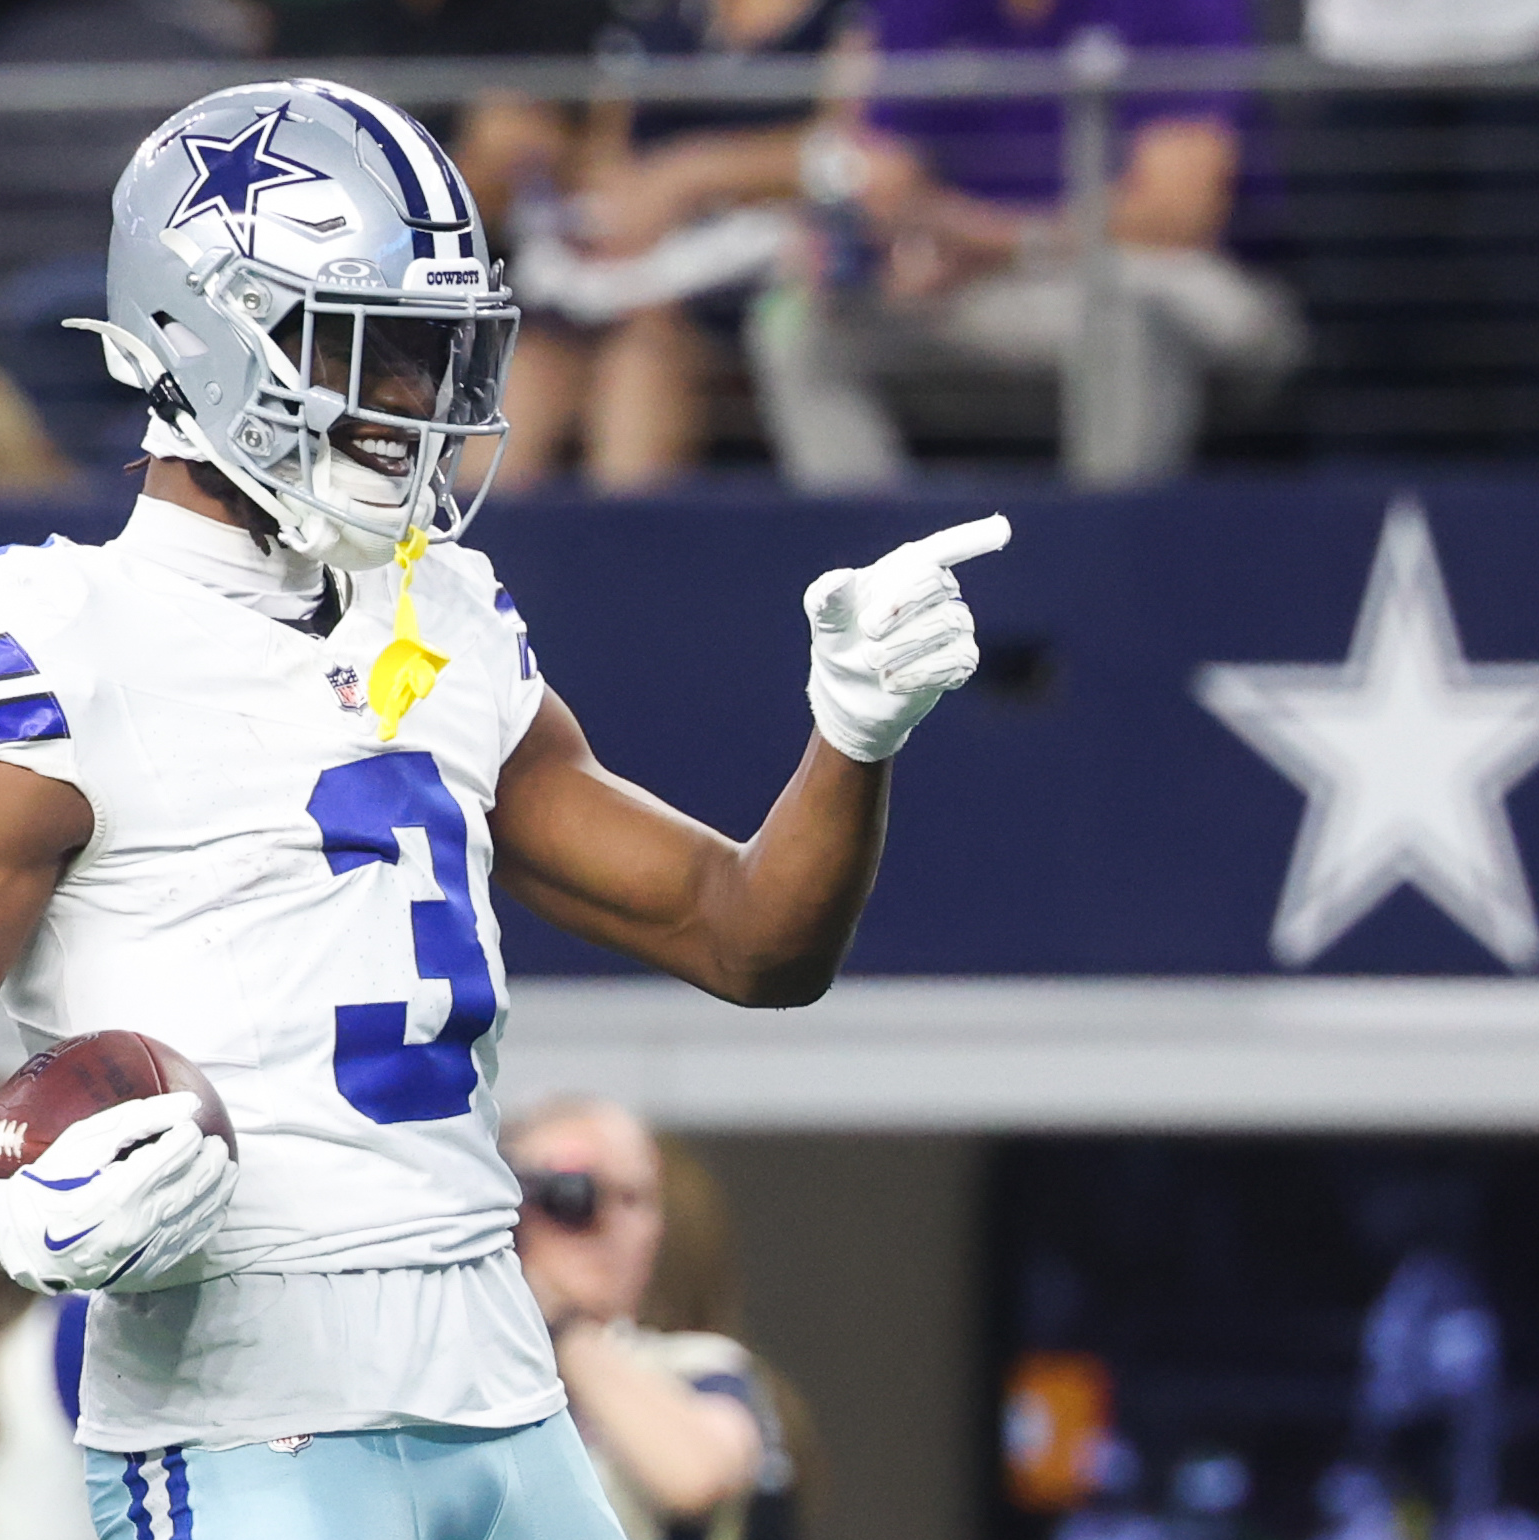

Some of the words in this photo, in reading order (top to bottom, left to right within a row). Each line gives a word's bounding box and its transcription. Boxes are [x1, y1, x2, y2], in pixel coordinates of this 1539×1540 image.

[317, 274, 380, 288] OAKLEY
[426, 271, 480, 286] COWBOYS
[305, 750, 497, 1125] 3
